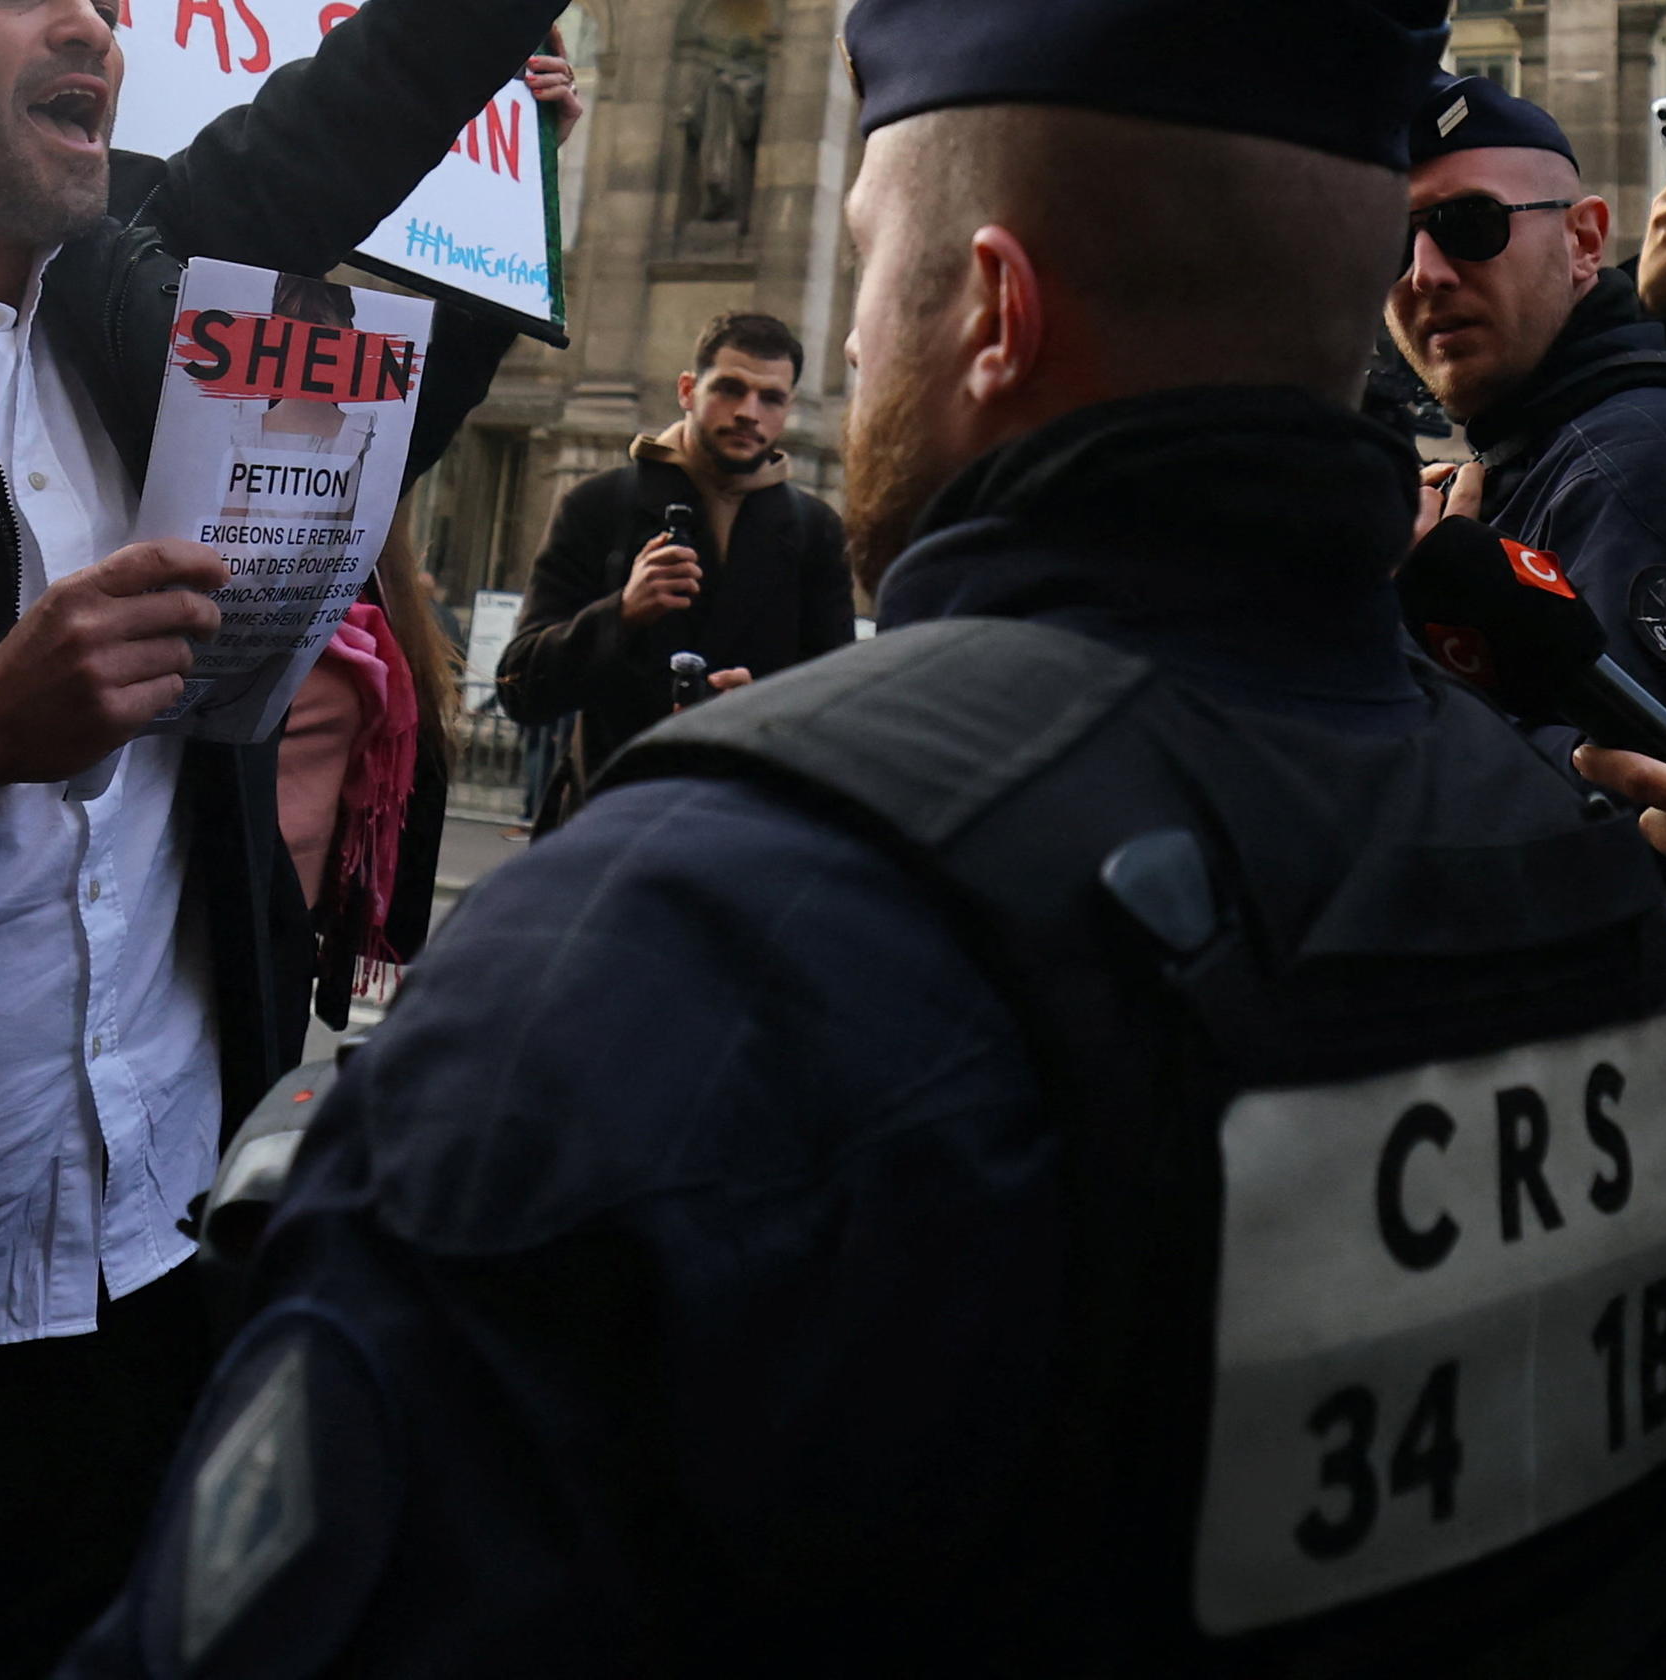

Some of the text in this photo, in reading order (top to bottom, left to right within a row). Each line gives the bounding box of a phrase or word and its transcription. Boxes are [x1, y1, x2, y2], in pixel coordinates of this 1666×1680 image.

[183, 309, 415, 404] SHEIN
[229, 462, 350, 498] PETITION
[200, 525, 366, 546] EXIGEONS LE RETRAIT
[266, 558, 296, 576] DES
[297, 554, 360, 575] POUPÉES
[308, 610, 327, 625] ET
[1374, 1061, 1633, 1273] CRS
[1293, 1358, 1465, 1563] 34
